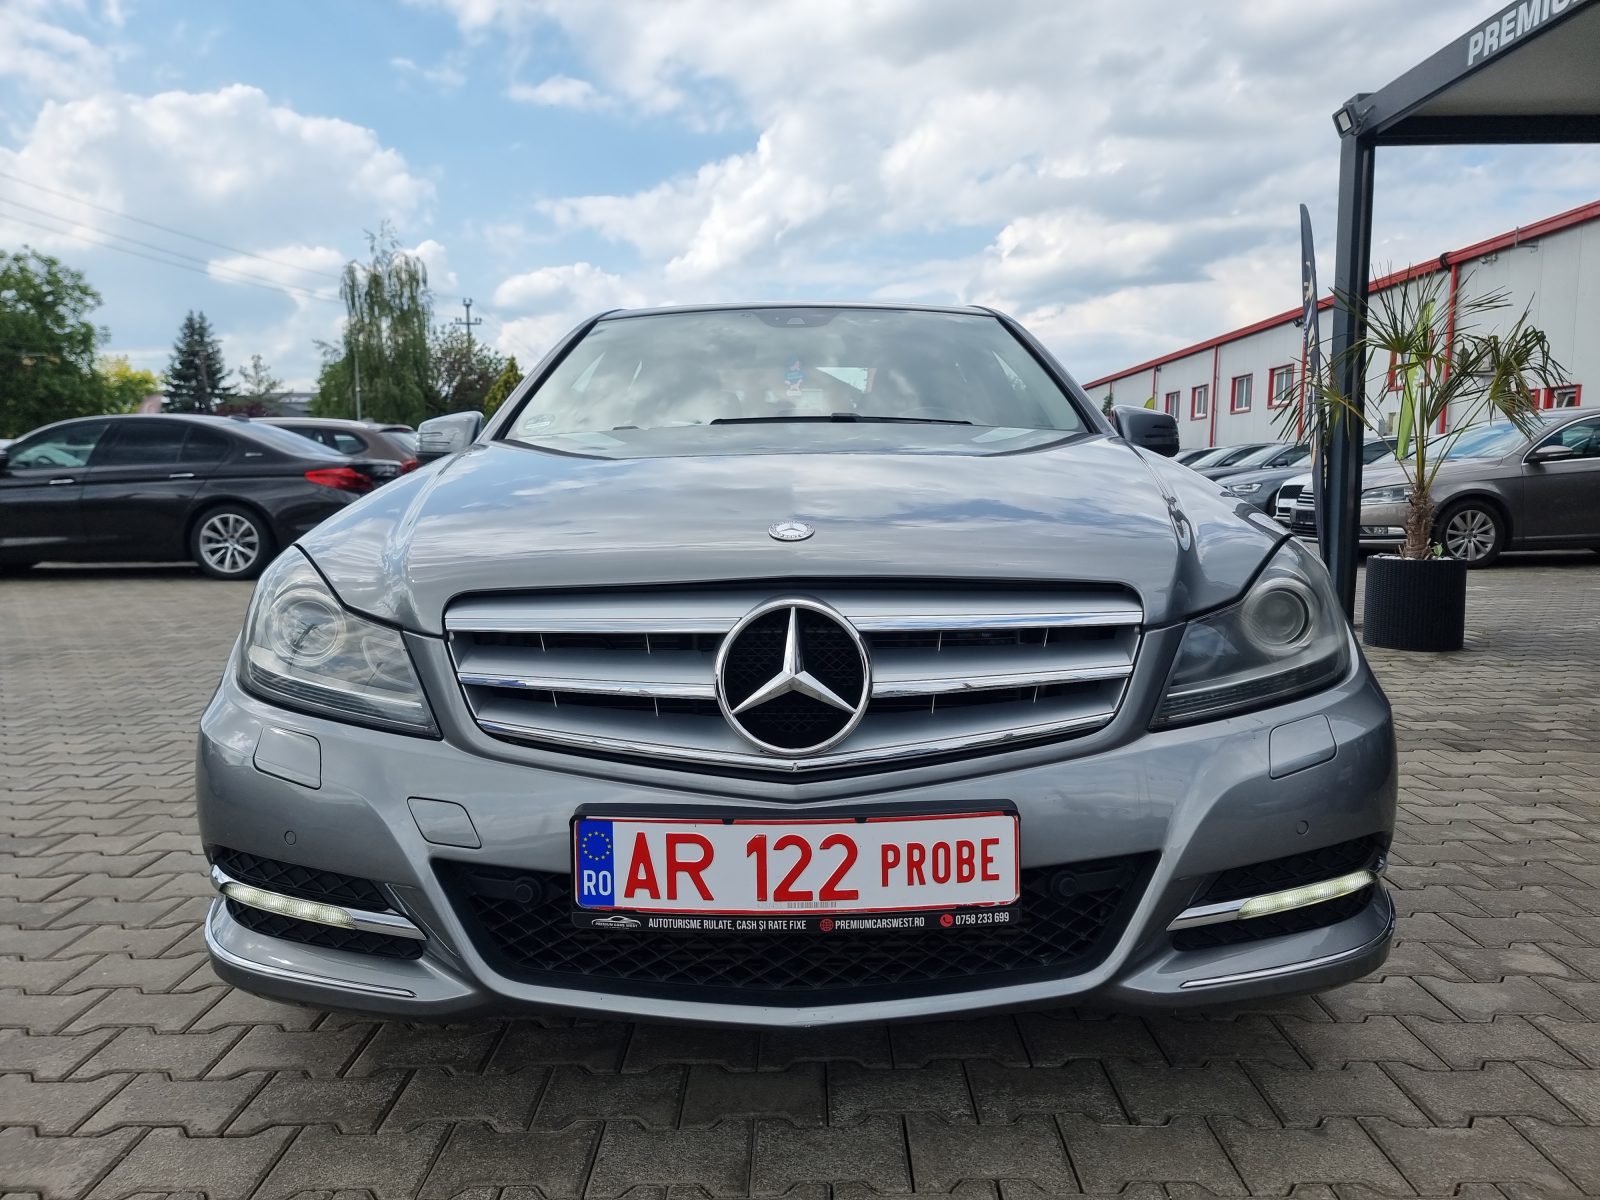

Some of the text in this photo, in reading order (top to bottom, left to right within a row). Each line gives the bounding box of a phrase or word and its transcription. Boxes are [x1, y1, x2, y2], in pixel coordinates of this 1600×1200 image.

[1468, 0, 1581, 66] PREMI
[624, 832, 1000, 902] AR 122 PROBE
[583, 869, 612, 896] RO
[648, 918, 701, 929] AUTOTURISME
[703, 919, 735, 930] RULATE,
[736, 920, 757, 930] CASH
[768, 920, 788, 930] RATE
[789, 920, 807, 930] FIXE
[835, 917, 925, 930] PREMIUMCARSWEST.RO
[955, 912, 1010, 925] 0758 233 699
